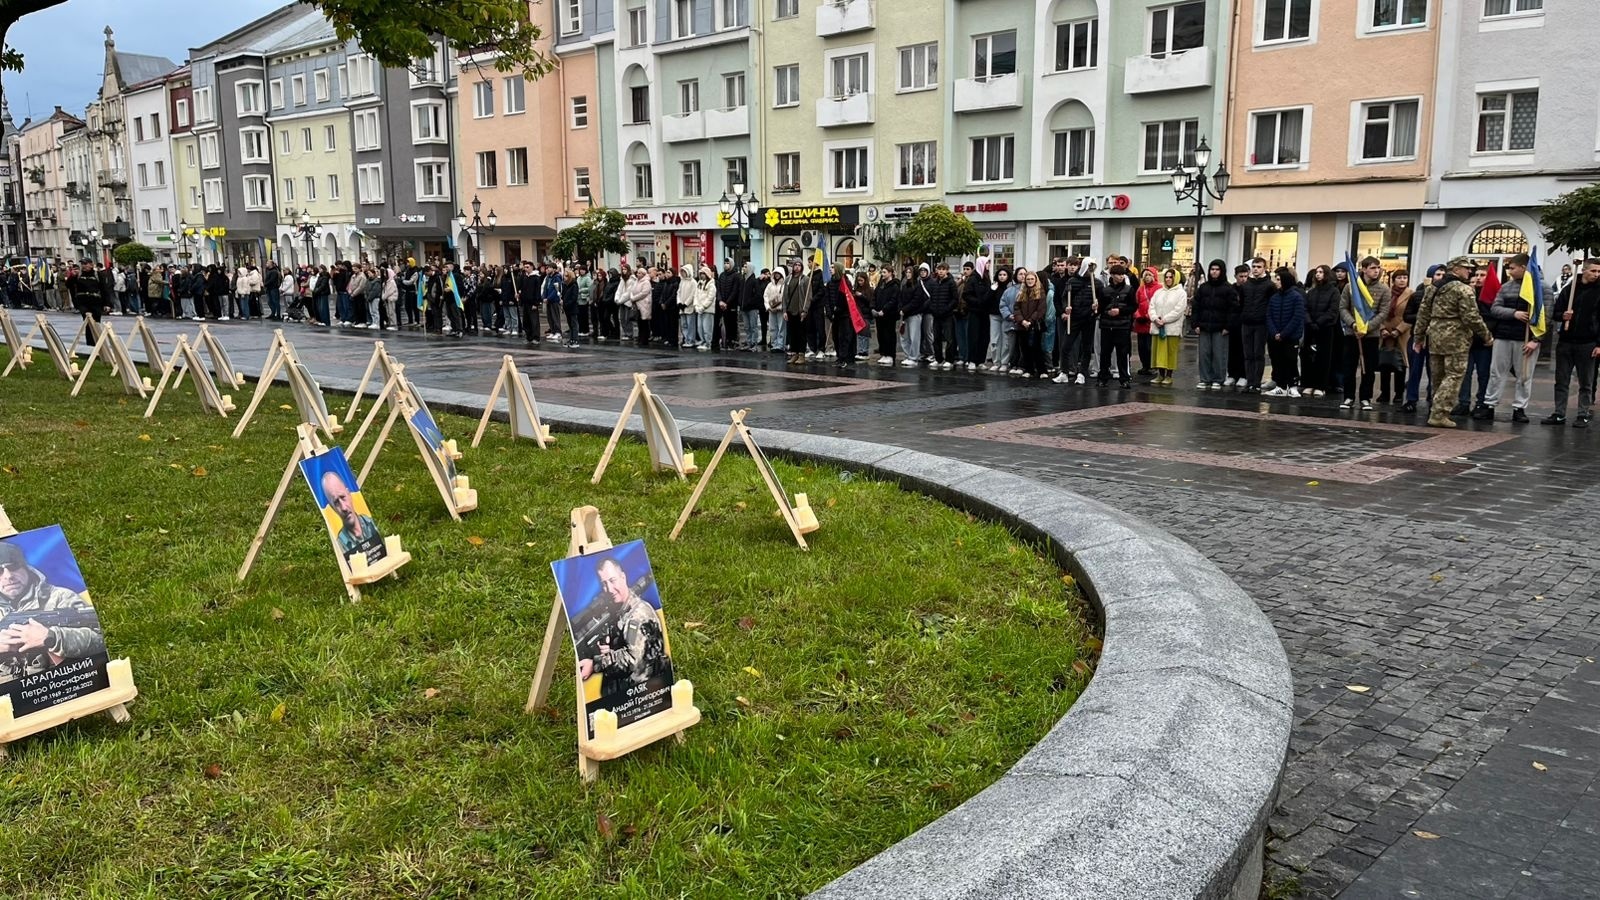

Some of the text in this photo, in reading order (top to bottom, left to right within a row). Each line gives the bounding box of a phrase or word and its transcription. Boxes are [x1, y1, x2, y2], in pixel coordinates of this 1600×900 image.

[661, 211, 699, 226] ГУДОК
[780, 207, 840, 219] СТОЛИЧНА
[985, 232, 1009, 240] МОНТ
[20, 657, 94, 688] ТАРАПАЦЬКИЙ
[21, 670, 98, 699] Петро Йосифович
[33, 691, 62, 705] 01.09.1969
[65, 680, 94, 693] 27.06.2022
[626, 682, 648, 696] ФЛЯК
[612, 686, 671, 713] Андрій Григорович
